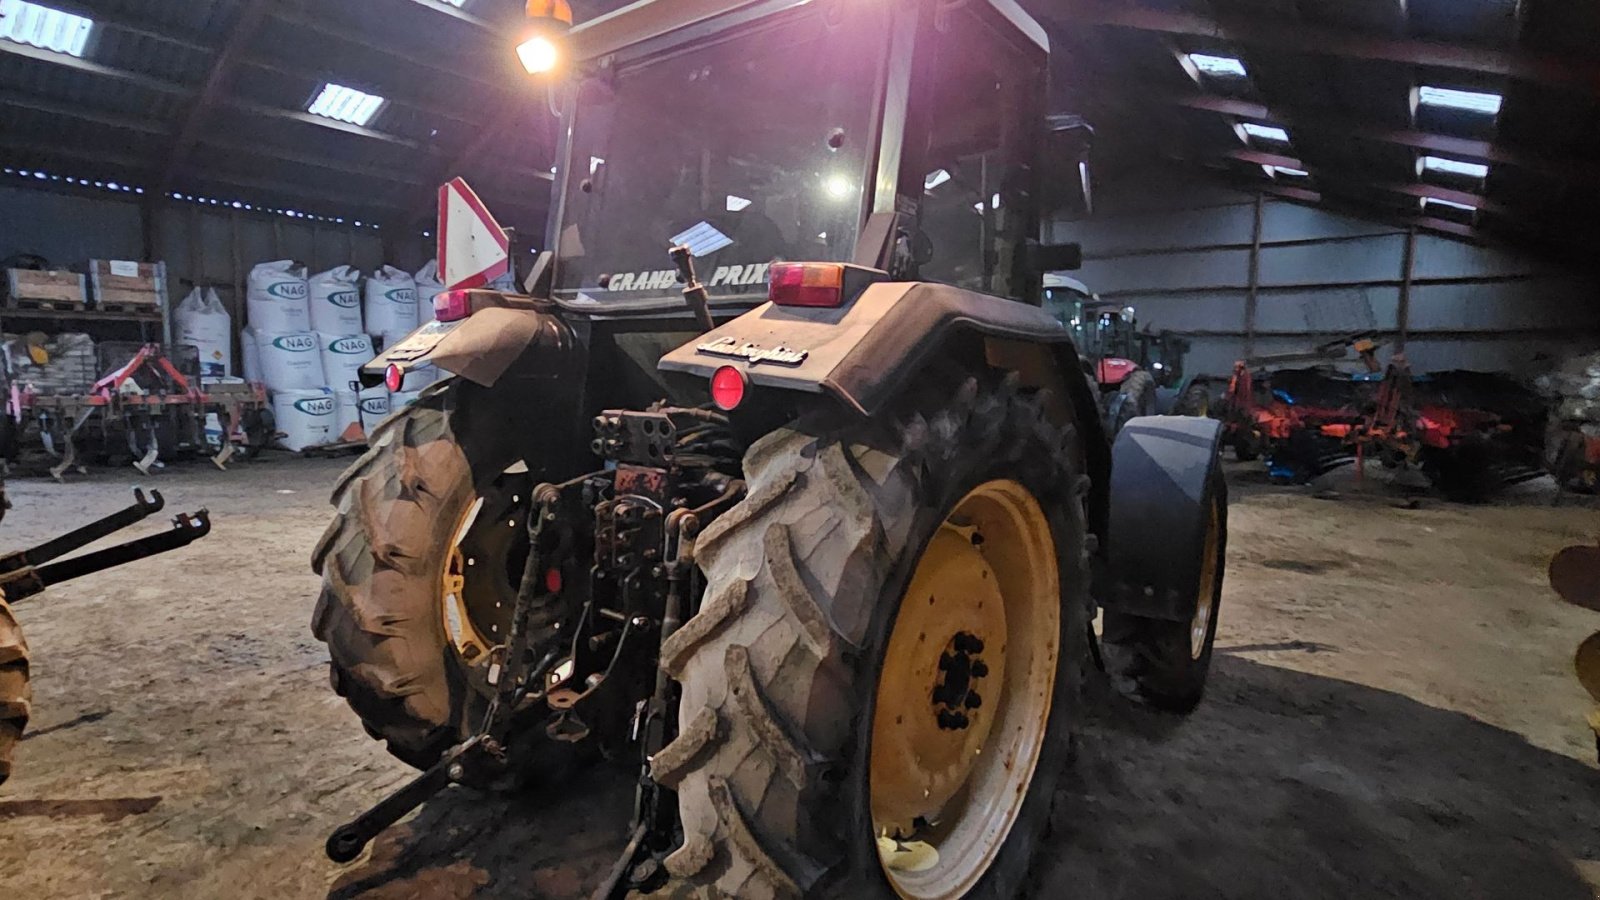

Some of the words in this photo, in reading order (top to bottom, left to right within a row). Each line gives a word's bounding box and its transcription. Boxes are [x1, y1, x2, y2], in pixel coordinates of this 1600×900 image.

[608, 270, 677, 291] GRAND
[710, 263, 769, 286] PRIX
[280, 285, 305, 295] NAG
[286, 338, 312, 348] NAG
[340, 340, 366, 351] NAG
[307, 400, 333, 411] NAG
